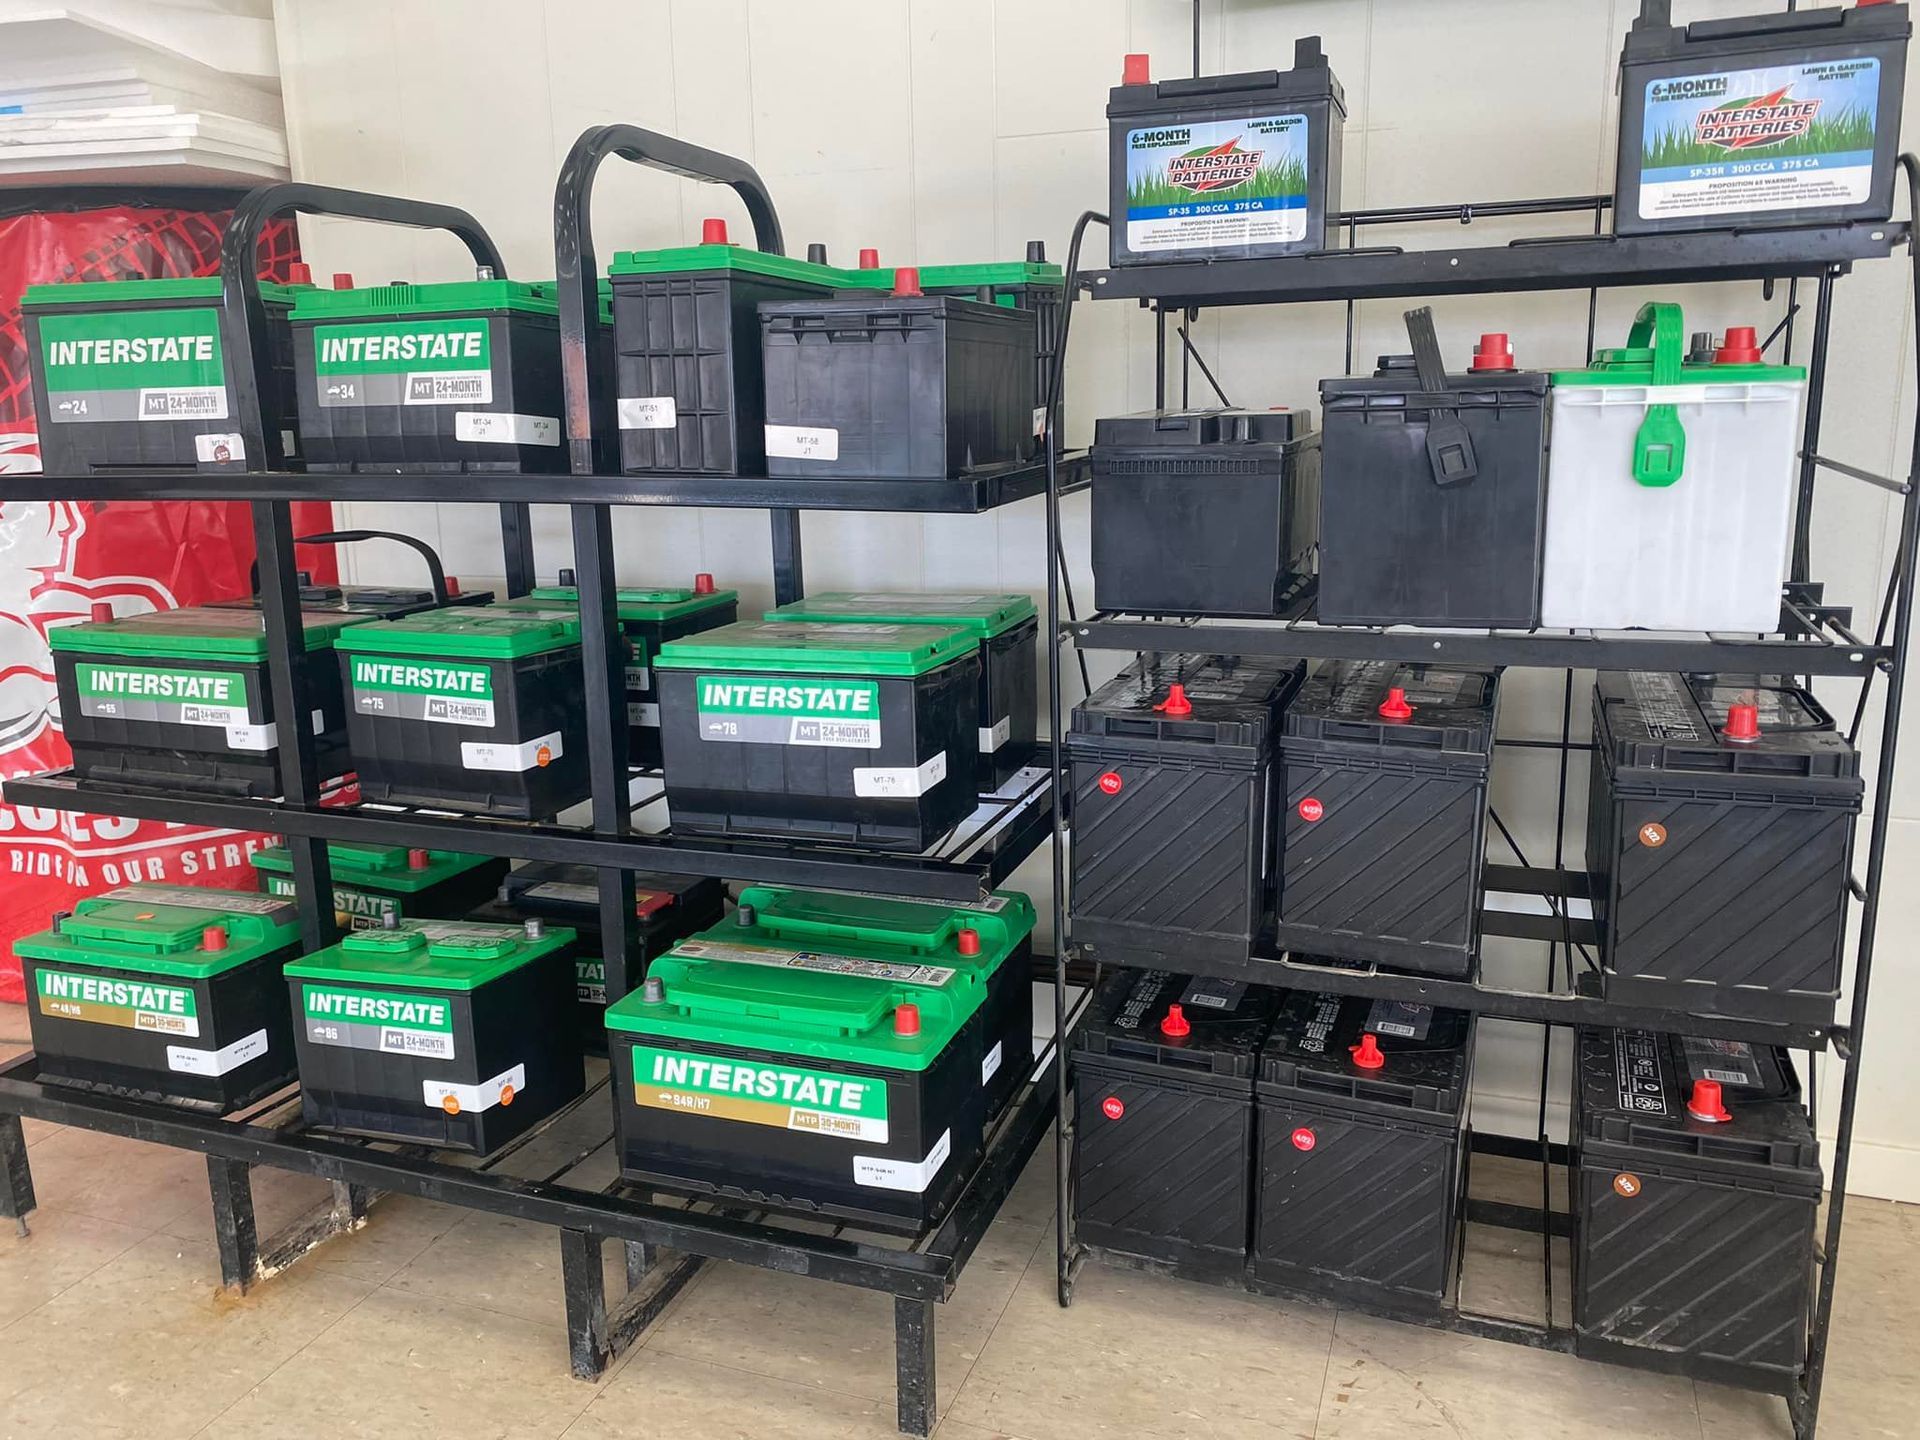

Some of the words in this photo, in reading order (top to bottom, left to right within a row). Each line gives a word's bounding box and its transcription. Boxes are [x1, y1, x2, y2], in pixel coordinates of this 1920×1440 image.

[1801, 66, 1827, 75] LAWN
[1837, 62, 1873, 73] GARDEN
[1817, 71, 1856, 82] BATTERY
[1651, 77, 1728, 96] 6-MONTH
[1699, 102, 1817, 125] INTERSTATE
[1247, 120, 1267, 129] LAWN
[1275, 118, 1303, 127] GARDEN
[1260, 126, 1290, 135] BATTERY
[1701, 119, 1806, 141] BATTERIES
[1131, 129, 1191, 143] 6-MONTH
[1170, 152, 1260, 170] INTERSTATE
[1689, 166, 1724, 178] SP-35R
[1731, 164, 1752, 175] 300
[1753, 161, 1775, 172] CCA
[1781, 159, 1802, 171] 375
[1804, 158, 1819, 169] CA
[1172, 166, 1253, 184] BATTERIES
[1709, 180, 1753, 190] PROPOSITION
[1764, 176, 1798, 186] WARNING
[1168, 206, 1190, 216] SP-35
[1195, 205, 1212, 214] 300
[1212, 203, 1230, 213] CCA
[1234, 202, 1251, 212] 375
[1251, 201, 1264, 210] CA
[50, 336, 214, 366] INTERSTATE
[321, 332, 483, 363] INTERSTATE
[340, 384, 355, 399] 34
[413, 381, 432, 395] MT
[435, 380, 483, 393] 24-MONTH
[73, 400, 88, 415] 24
[148, 397, 166, 411] MT
[170, 396, 217, 409] 24-MONTH
[638, 404, 659, 413] MT-51
[472, 418, 491, 426] MT-34
[357, 662, 486, 693] INTERSTATE
[91, 670, 229, 700] INTERSTATE
[372, 697, 384, 710] 75
[703, 684, 872, 712] INTERSTATE
[432, 704, 446, 714] MT
[448, 704, 487, 717] 24-MONTH
[723, 721, 738, 736] 78
[800, 726, 818, 736] MT
[822, 725, 870, 739] 24-MONTH
[10, 849, 62, 878] RIDE
[67, 860, 90, 887] ON
[102, 856, 166, 885] OUR
[45, 973, 185, 1012] INTERSTATE
[309, 992, 445, 1025] INTERSTATE
[139, 1014, 156, 1026] MTP
[325, 1027, 338, 1040] 86
[388, 1034, 403, 1045] MT
[406, 1036, 446, 1050] 24-MONTH
[652, 1055, 863, 1111] INTERSTATE
[673, 1095, 711, 1111] 94R/H7
[796, 1113, 818, 1126] MTP
[820, 1117, 861, 1132] 30-MONTH
